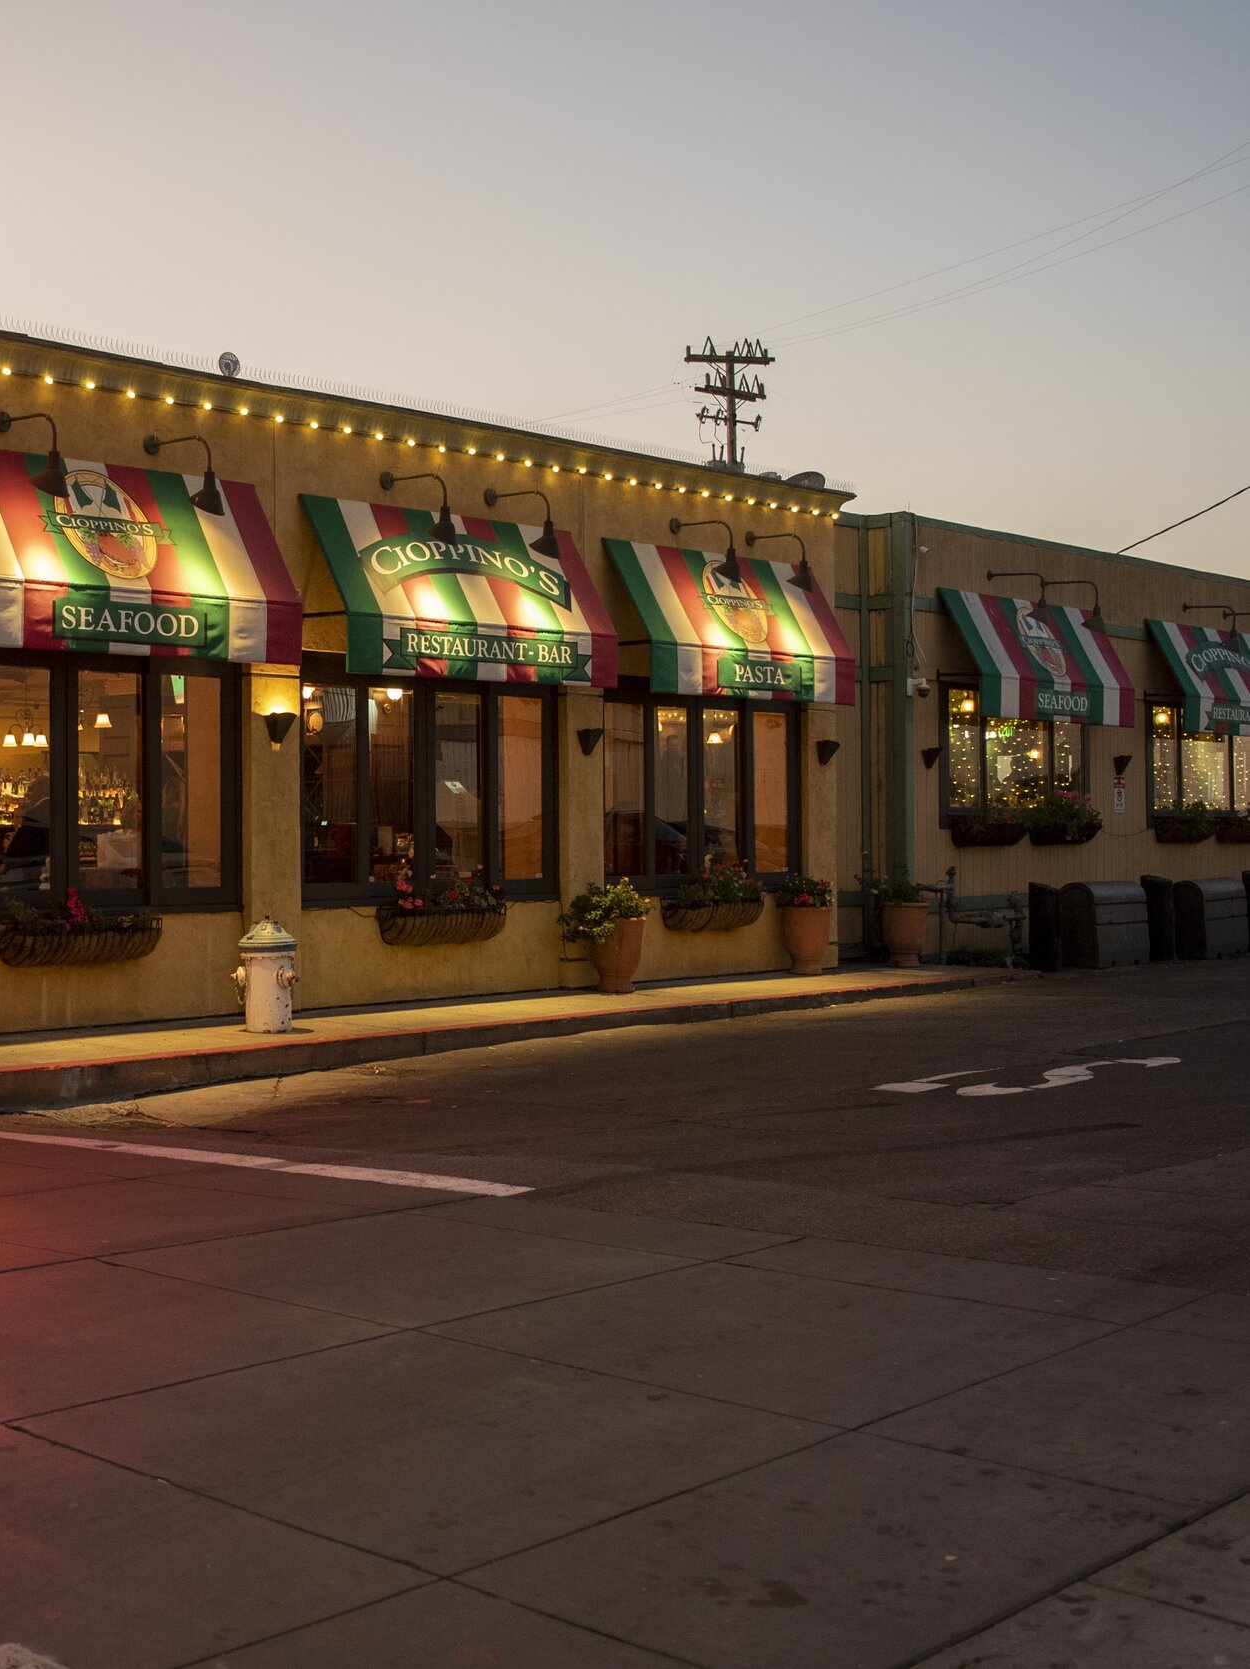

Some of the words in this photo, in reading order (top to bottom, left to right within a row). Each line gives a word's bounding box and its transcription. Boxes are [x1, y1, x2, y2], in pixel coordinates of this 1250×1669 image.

[56, 513, 154, 536] CIOPPINO'S
[370, 540, 561, 596] CIOPPINO'S
[707, 594, 763, 610] CIOPPINO'S
[61, 605, 199, 638] SEAFOOD
[406, 633, 528, 661] RESTAURANT
[537, 644, 572, 665] BAR
[734, 663, 786, 685] PASTA
[1038, 693, 1088, 712] SEAFOOD
